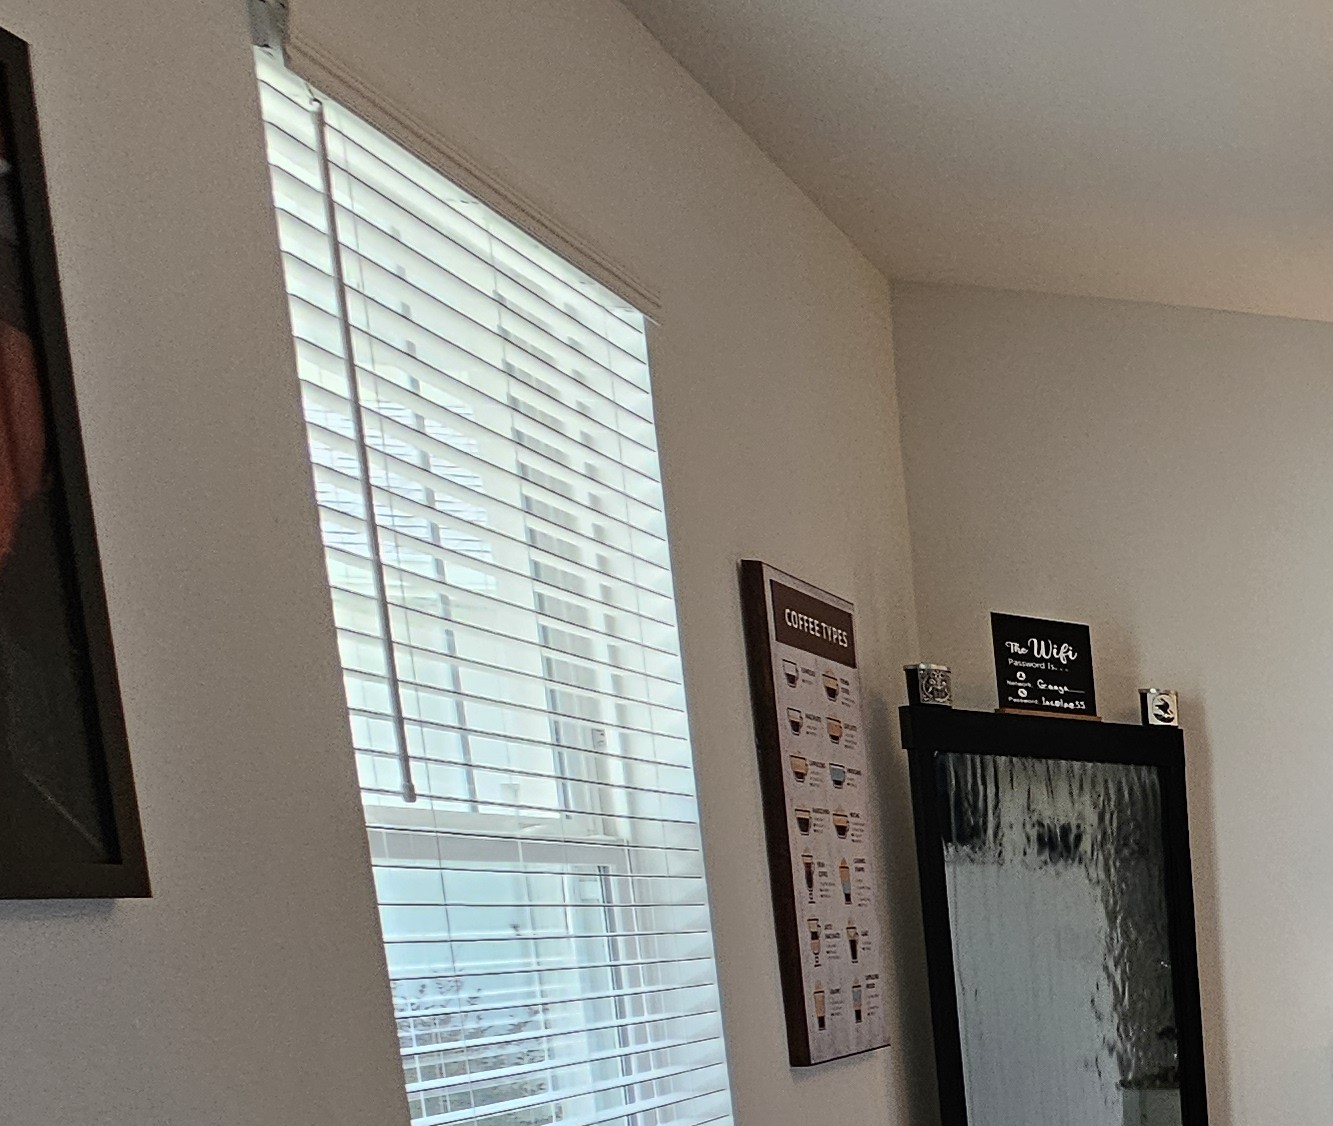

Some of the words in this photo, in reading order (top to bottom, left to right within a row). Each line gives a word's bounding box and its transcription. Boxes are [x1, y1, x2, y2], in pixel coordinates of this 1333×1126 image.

[785, 608, 821, 638] COFFEE
[821, 622, 848, 648] TYPES
[1005, 641, 1028, 654] The
[1028, 638, 1078, 665] Wifi
[1008, 658, 1046, 670] Password
